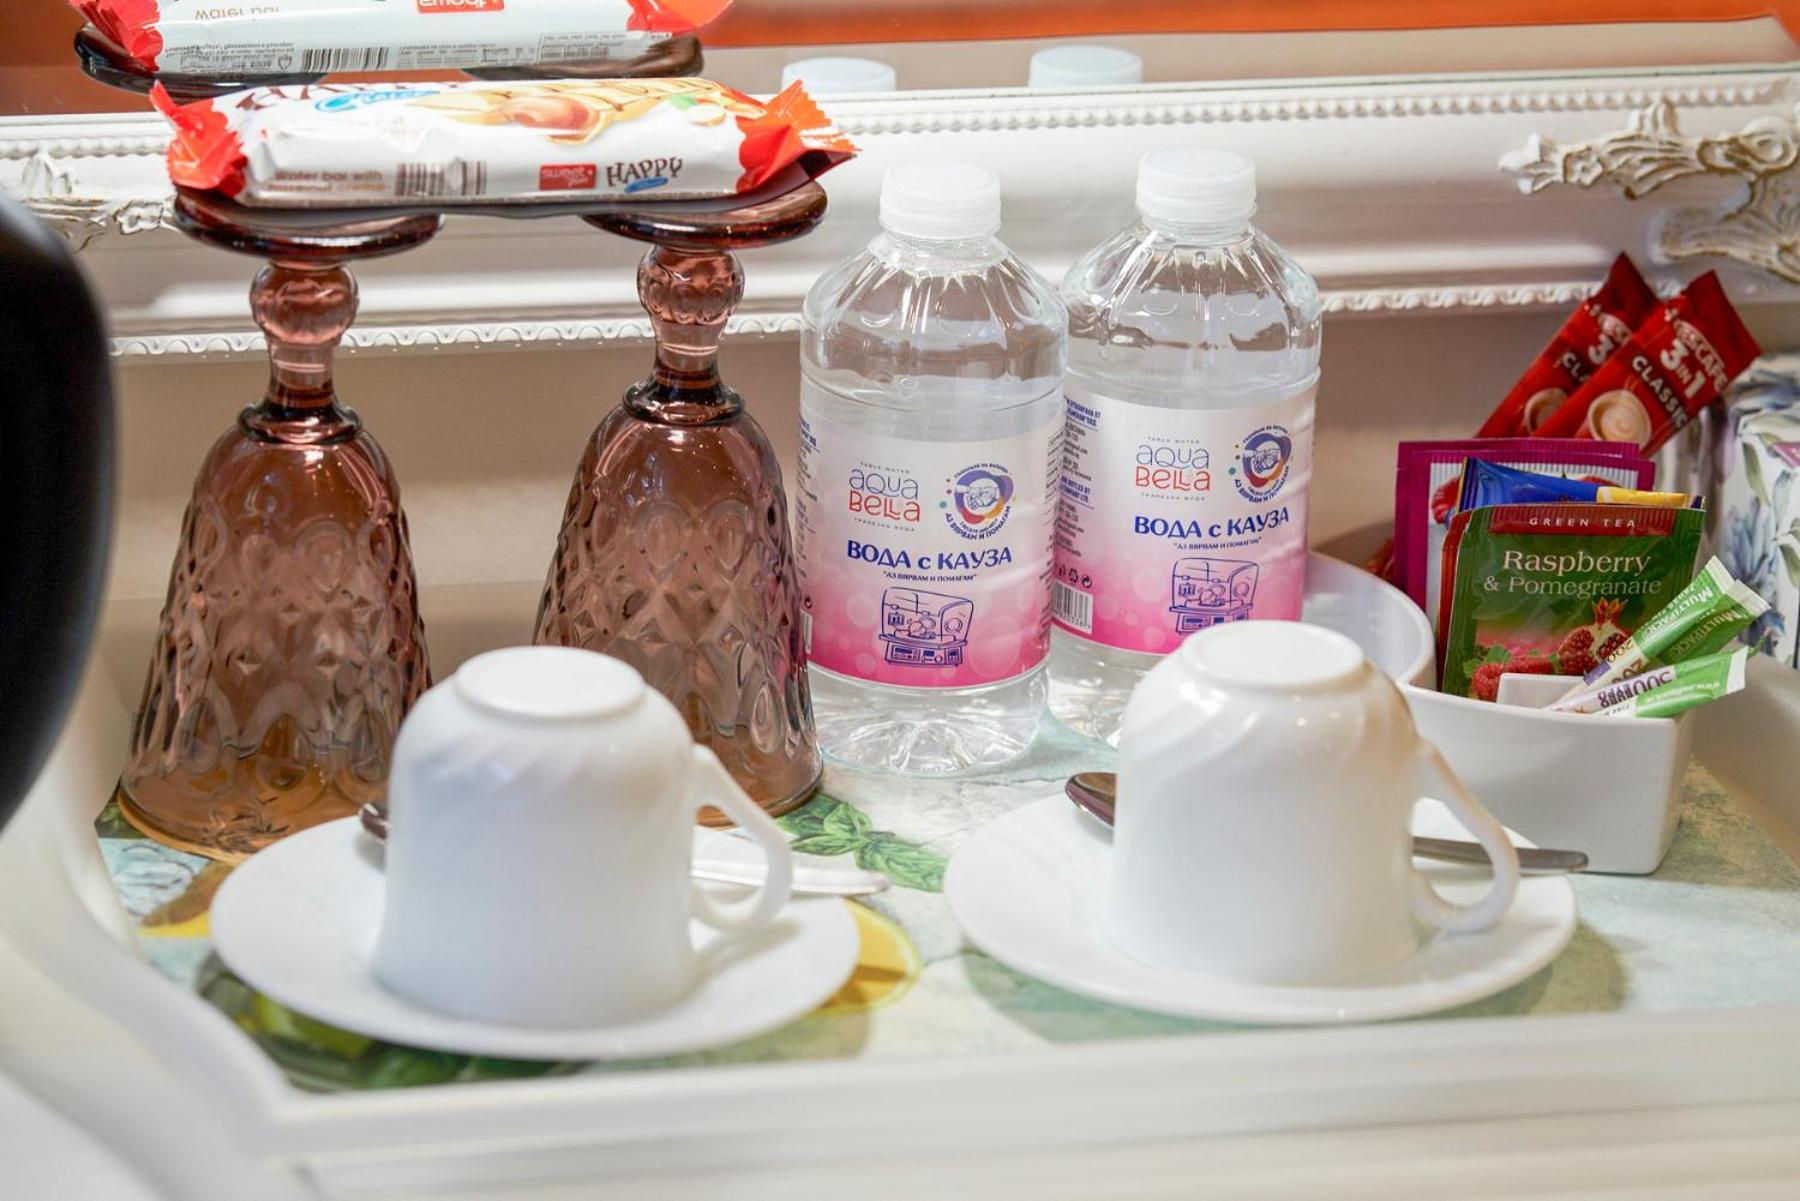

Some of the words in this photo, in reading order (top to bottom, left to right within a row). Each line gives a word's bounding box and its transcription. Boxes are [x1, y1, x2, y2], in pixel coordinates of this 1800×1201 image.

[606, 157, 683, 187] HAPPY
[1631, 355, 1690, 429] CLASSIC
[1134, 516, 1202, 539] ВОДА
[1226, 506, 1290, 537] КАУЗА
[1528, 516, 1591, 527] GREEN
[1603, 518, 1636, 529] TEA
[847, 539, 912, 569] ВОДА
[937, 546, 1013, 570] КАУЗА
[1502, 549, 1651, 577] Raspberry
[1483, 575, 1499, 592] &
[1508, 576, 1662, 600] Pomegranate
